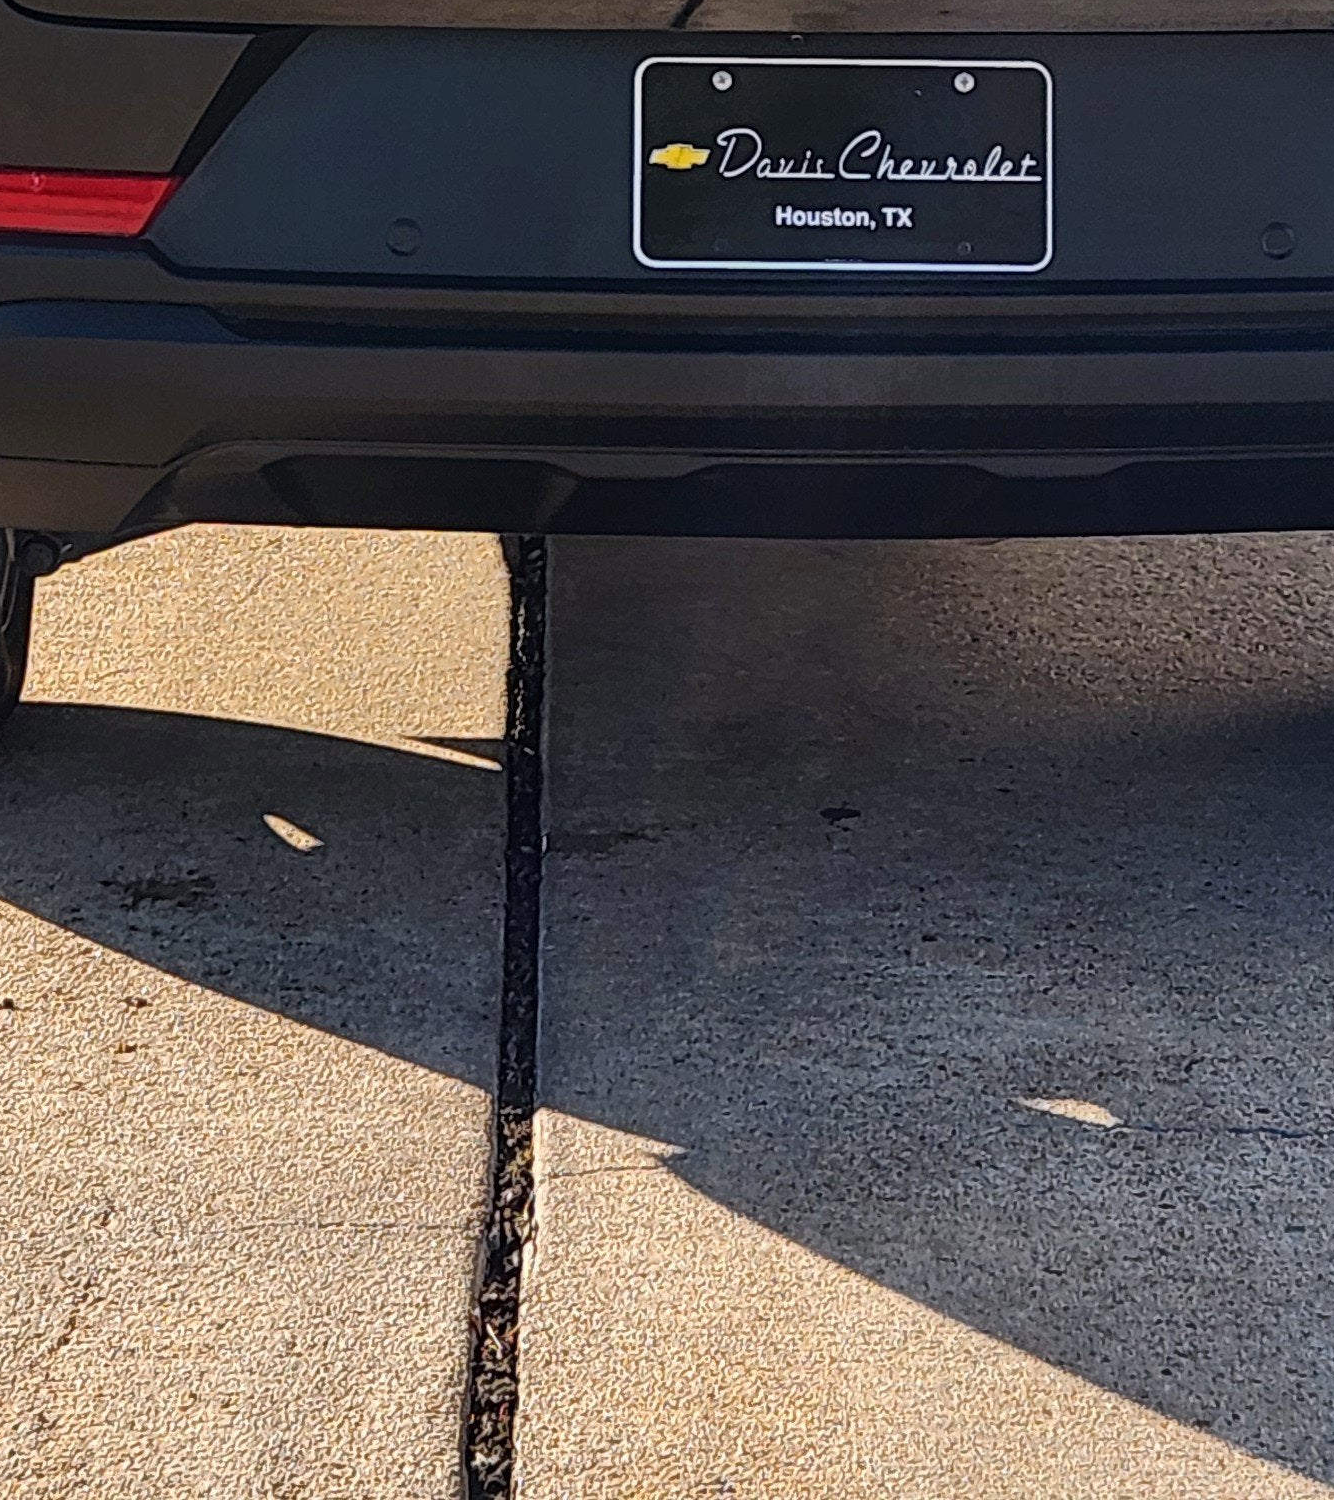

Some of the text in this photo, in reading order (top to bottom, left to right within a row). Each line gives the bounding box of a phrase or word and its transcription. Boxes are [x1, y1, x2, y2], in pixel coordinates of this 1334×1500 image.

[716, 127, 1043, 182] Davis Chevrolet
[774, 205, 913, 231] Houston, TX
